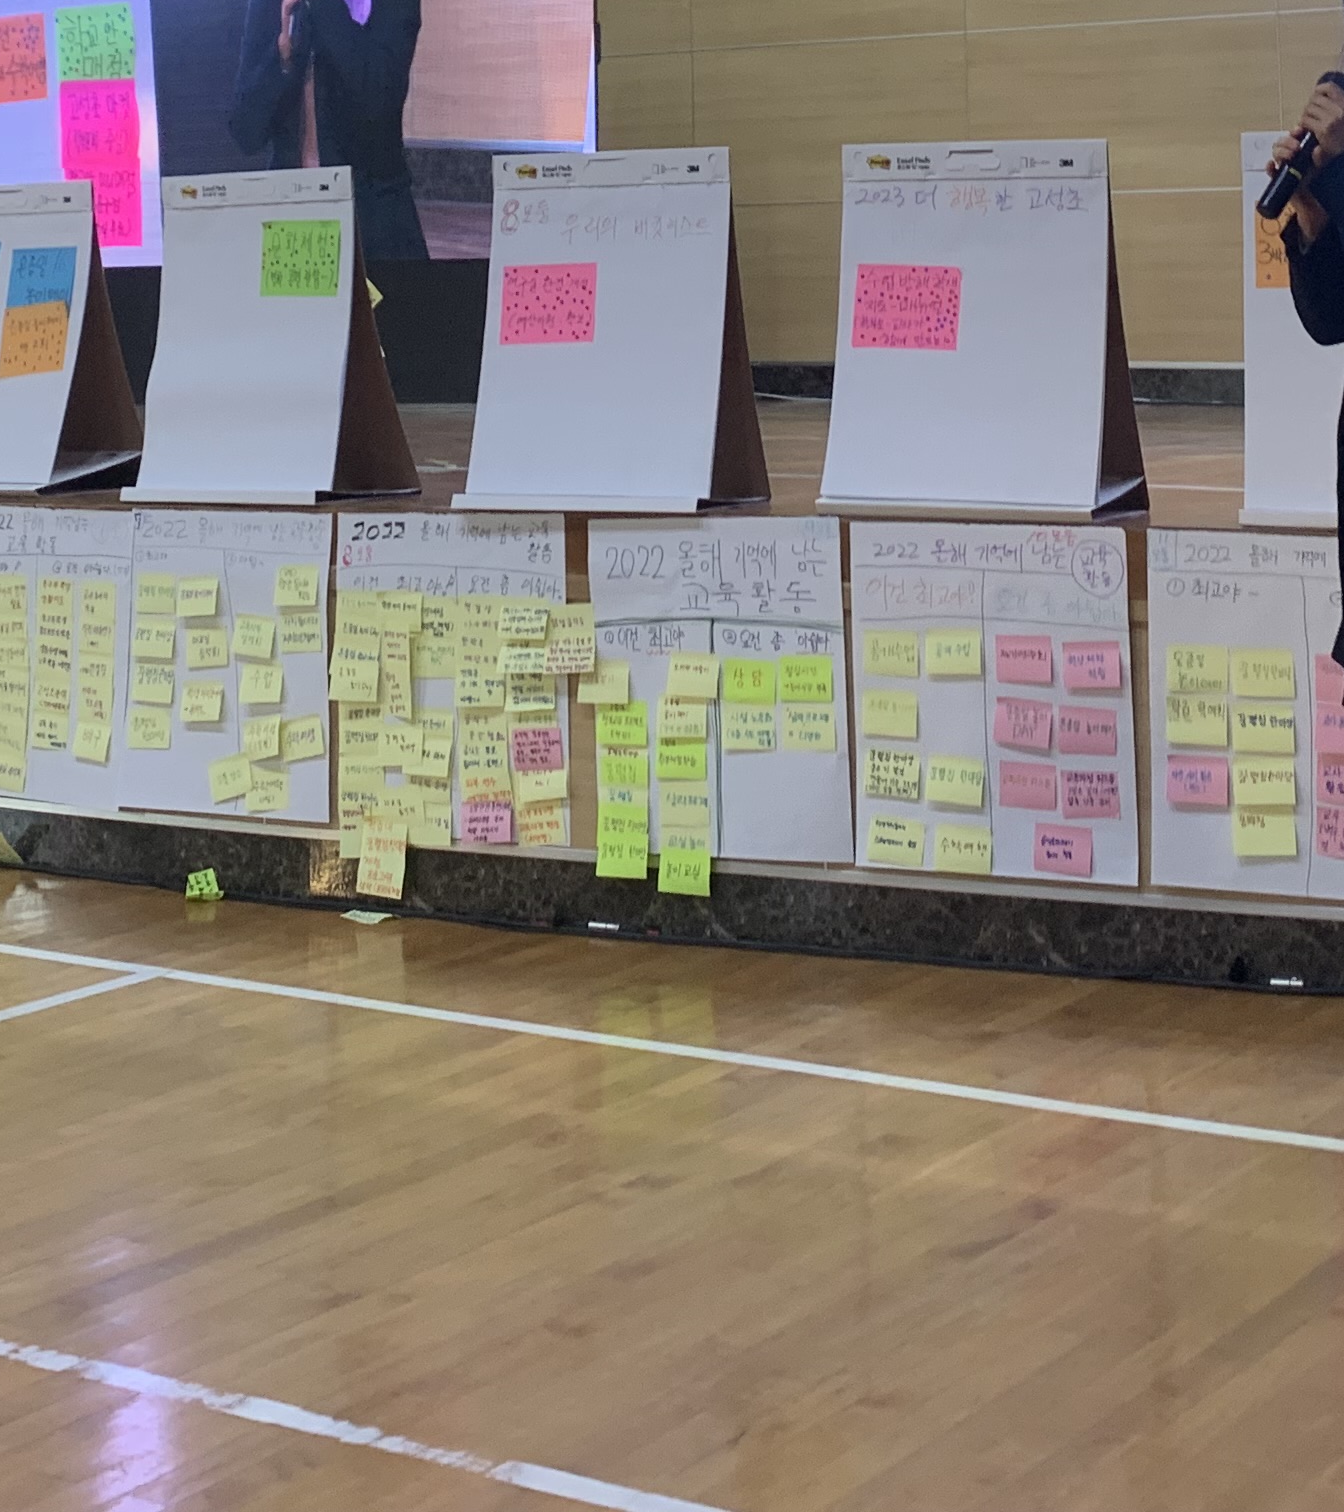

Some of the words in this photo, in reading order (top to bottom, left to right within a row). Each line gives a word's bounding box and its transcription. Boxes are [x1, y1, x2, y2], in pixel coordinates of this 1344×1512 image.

[854, 187, 906, 207] 2023
[606, 545, 665, 580] 2022
[678, 538, 723, 584] 올해
[735, 539, 776, 580] 기억에
[791, 539, 827, 577] 남는
[873, 543, 920, 559] 2022
[1183, 543, 1232, 564] 2022
